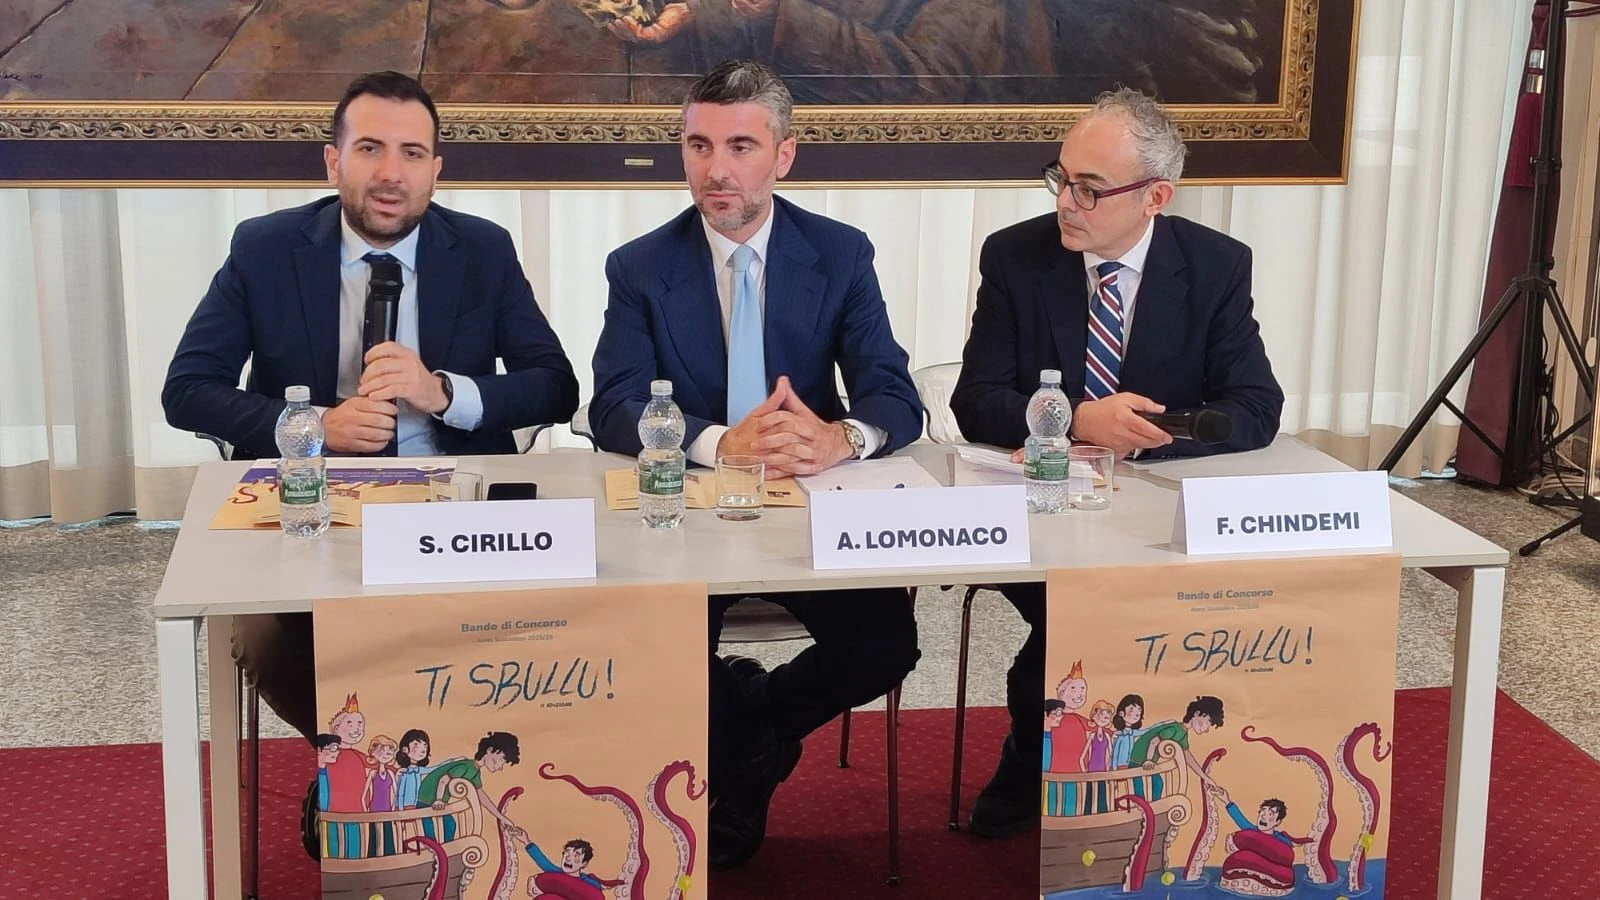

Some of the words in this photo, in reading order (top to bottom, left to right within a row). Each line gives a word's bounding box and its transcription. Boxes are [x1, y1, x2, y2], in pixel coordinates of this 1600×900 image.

[1216, 517, 1234, 535] F.
[1240, 512, 1360, 534] CHINDEMI
[419, 535, 443, 554] S.
[451, 532, 553, 553] CIRILLO
[837, 532, 860, 550] A.
[866, 526, 1008, 549] LOMONACO
[1177, 591, 1210, 600] Bando
[1213, 590, 1223, 599] di
[1226, 589, 1273, 599] Concorso
[461, 623, 498, 633] Bando
[501, 620, 512, 630] di
[515, 618, 567, 629] Concorso
[1135, 633, 1169, 676] TI
[415, 664, 455, 710] TI
